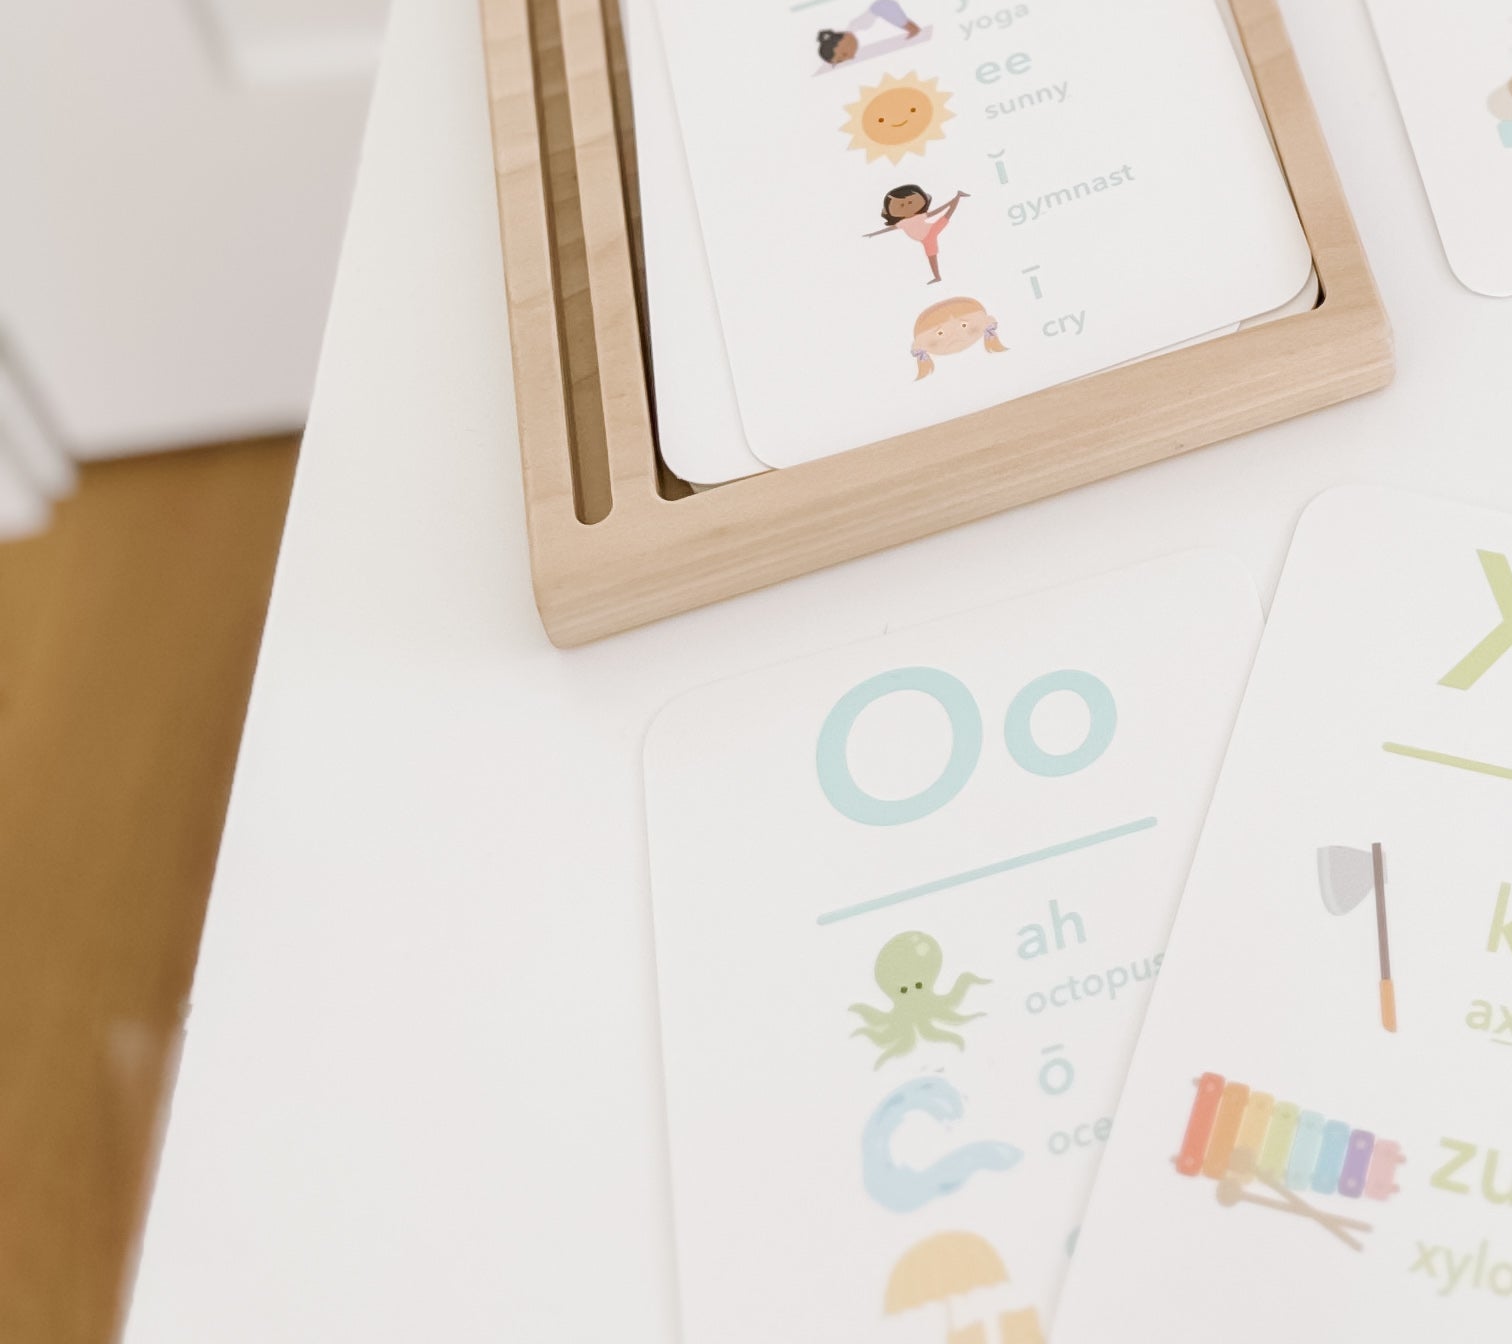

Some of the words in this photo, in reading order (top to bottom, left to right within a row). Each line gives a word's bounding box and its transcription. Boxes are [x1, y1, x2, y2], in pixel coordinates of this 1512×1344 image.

[959, 3, 1030, 41] yoga
[975, 52, 1031, 85] ee
[984, 80, 1068, 120] sunny
[1007, 164, 1135, 227] gymnast
[1042, 310, 1085, 337] cry
[815, 666, 1118, 827] Oo
[1017, 899, 1087, 961] ah
